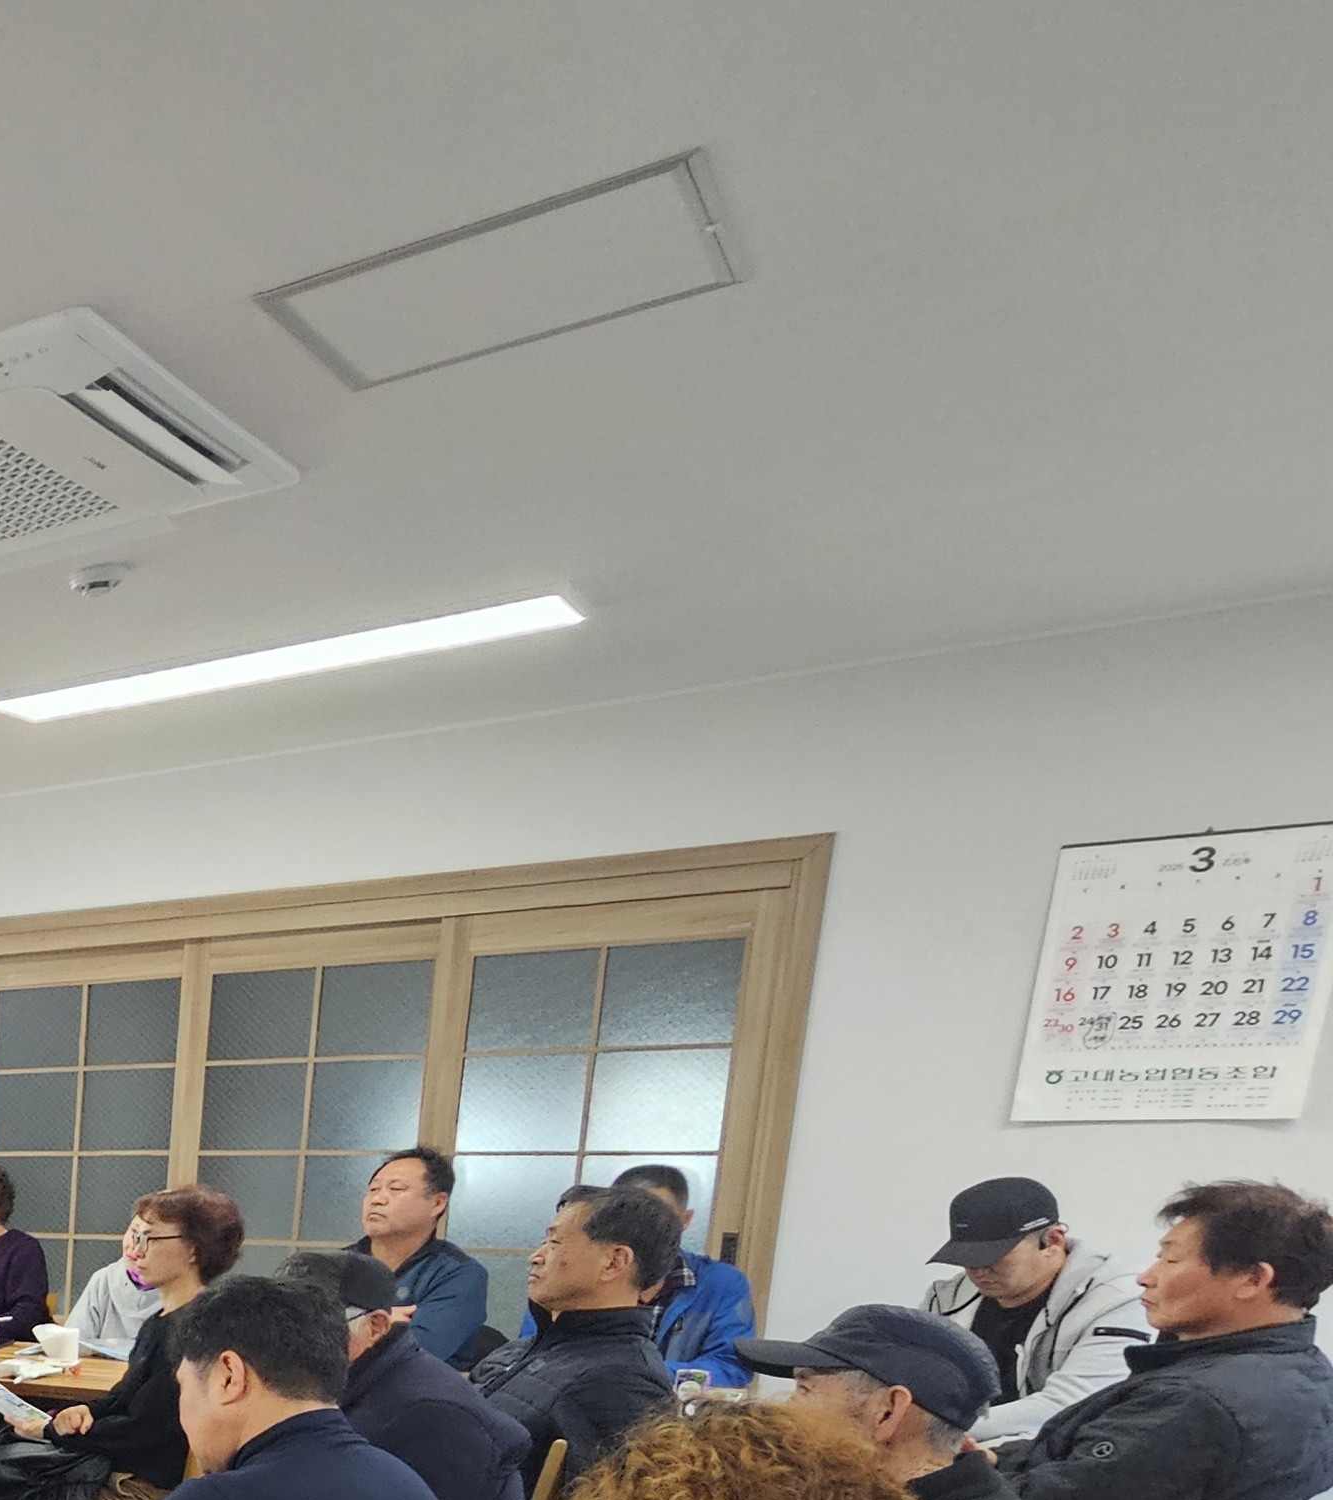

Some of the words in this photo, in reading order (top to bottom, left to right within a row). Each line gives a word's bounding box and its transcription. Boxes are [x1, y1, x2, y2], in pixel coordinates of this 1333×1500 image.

[1189, 846, 1217, 872] 3
[1071, 926, 1083, 940] 2
[1107, 923, 1120, 938] 3
[1144, 921, 1157, 935] 4
[1182, 918, 1196, 932] 5
[1221, 916, 1235, 930] 6
[1263, 913, 1277, 928] 7
[1302, 910, 1317, 925] 8
[1065, 957, 1077, 971] 9
[1097, 955, 1117, 968] 10
[1137, 953, 1151, 967] 11
[1173, 950, 1193, 964] 12
[1211, 948, 1233, 962] 13
[1251, 946, 1272, 960] 14
[1292, 944, 1315, 958] 15
[1055, 988, 1075, 1002] 16
[1093, 986, 1111, 1000] 17
[1127, 984, 1148, 998] 18
[1165, 983, 1186, 996] 19
[1199, 981, 1227, 995] 20
[1241, 978, 1265, 993] 21
[1281, 977, 1309, 992] 22
[1119, 1016, 1143, 1030] 25
[1155, 1014, 1181, 1028] 26
[1194, 1012, 1221, 1027] 27
[1233, 1010, 1260, 1026] 28
[1272, 1009, 1302, 1025] 29
[1066, 1065, 1278, 1082] 고대농업협동조합
